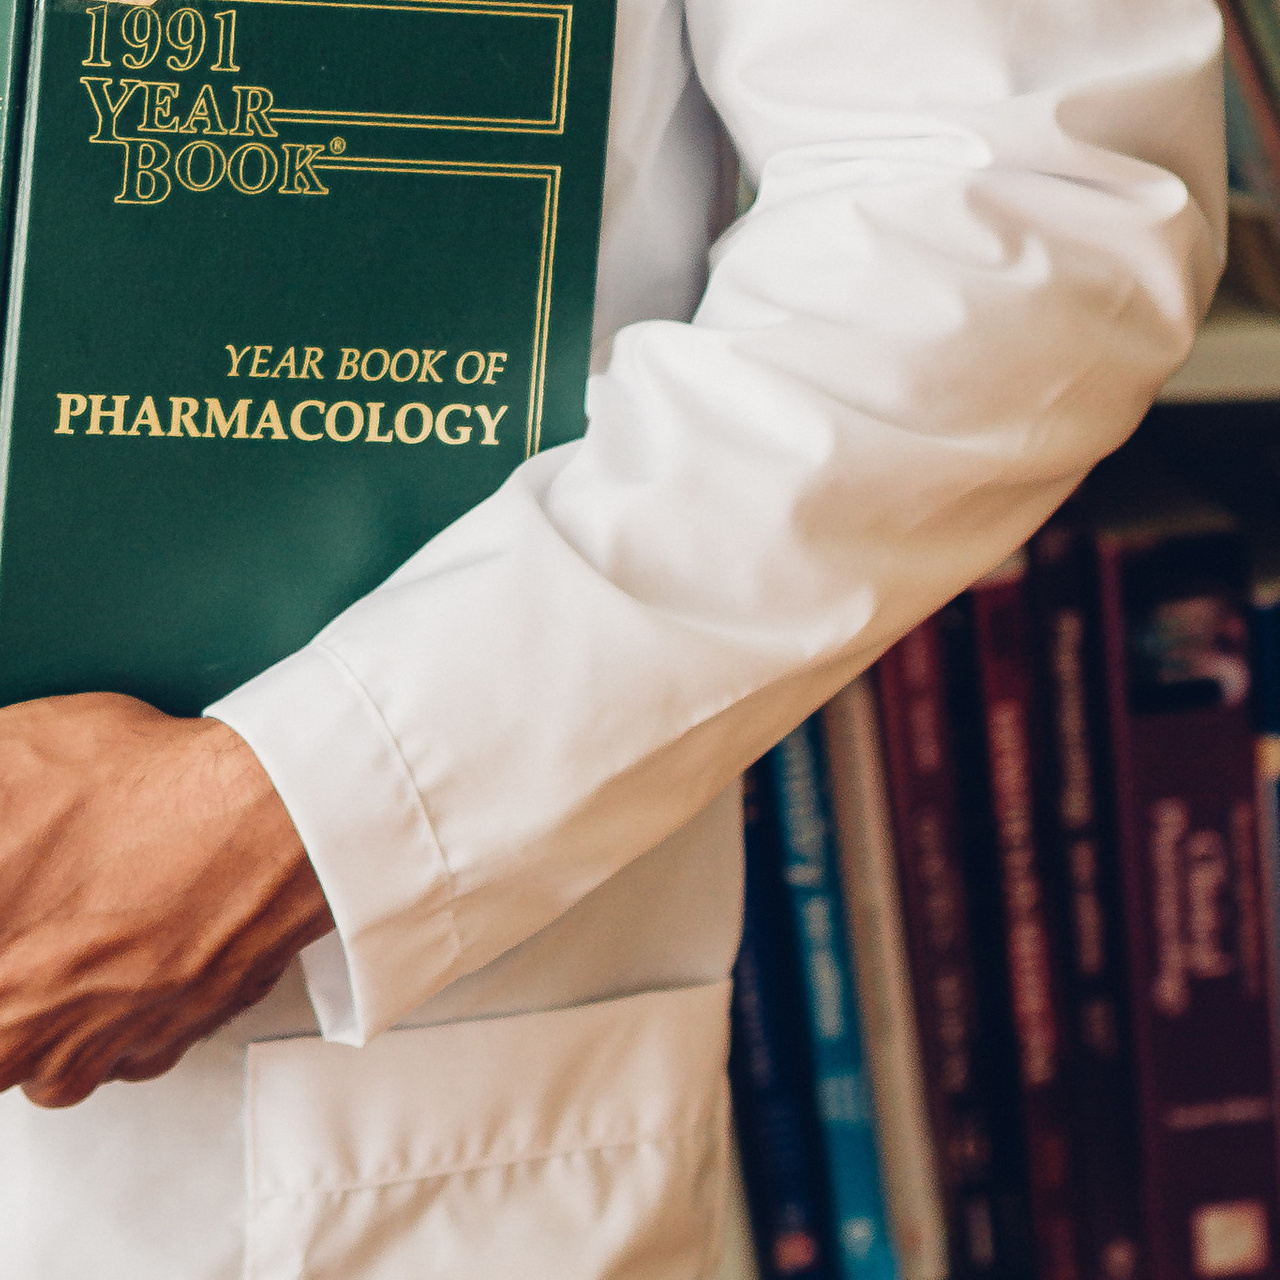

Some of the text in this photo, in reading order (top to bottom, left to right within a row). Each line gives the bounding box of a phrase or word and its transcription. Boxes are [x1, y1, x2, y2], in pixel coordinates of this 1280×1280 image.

[81, 2, 241, 72] 1991
[79, 76, 279, 144] YEAR
[224, 344, 508, 386] YEAR BOOK OF
[54, 393, 509, 446] PHARMACOLOGY
